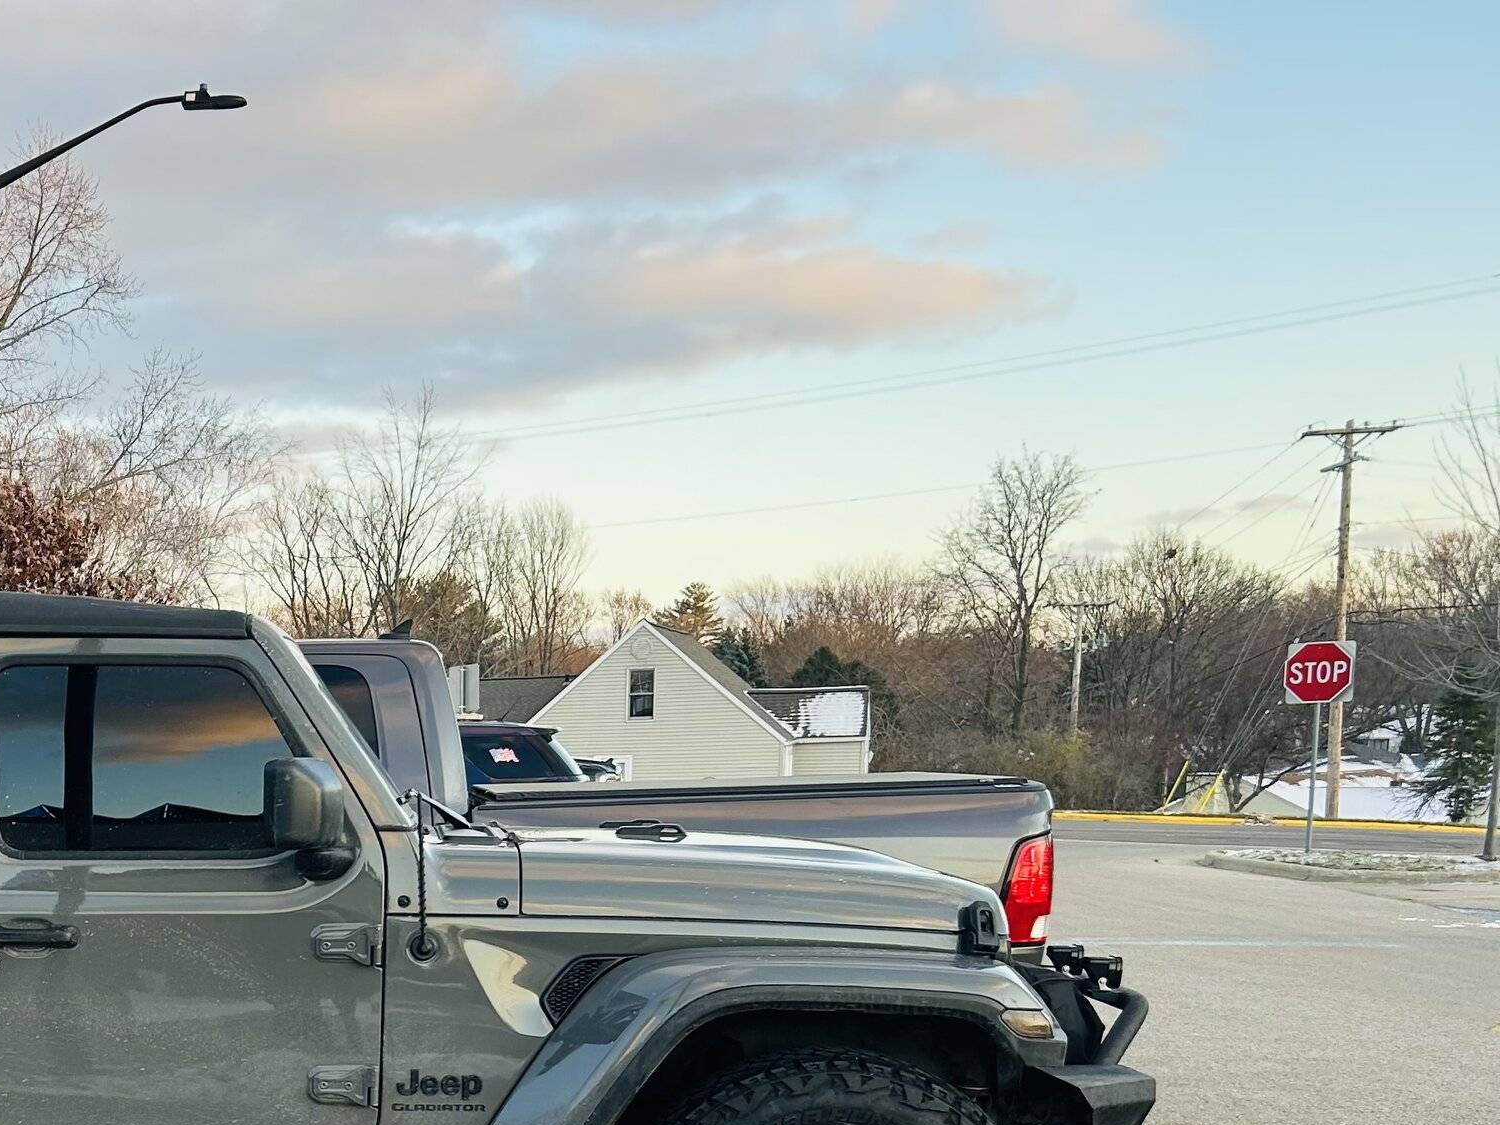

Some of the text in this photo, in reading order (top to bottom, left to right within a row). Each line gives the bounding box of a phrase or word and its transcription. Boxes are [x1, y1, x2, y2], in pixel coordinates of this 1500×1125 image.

[1289, 660, 1348, 685] STOP
[396, 1068, 483, 1101] Jeep
[391, 1103, 486, 1112] GLADIATOR
